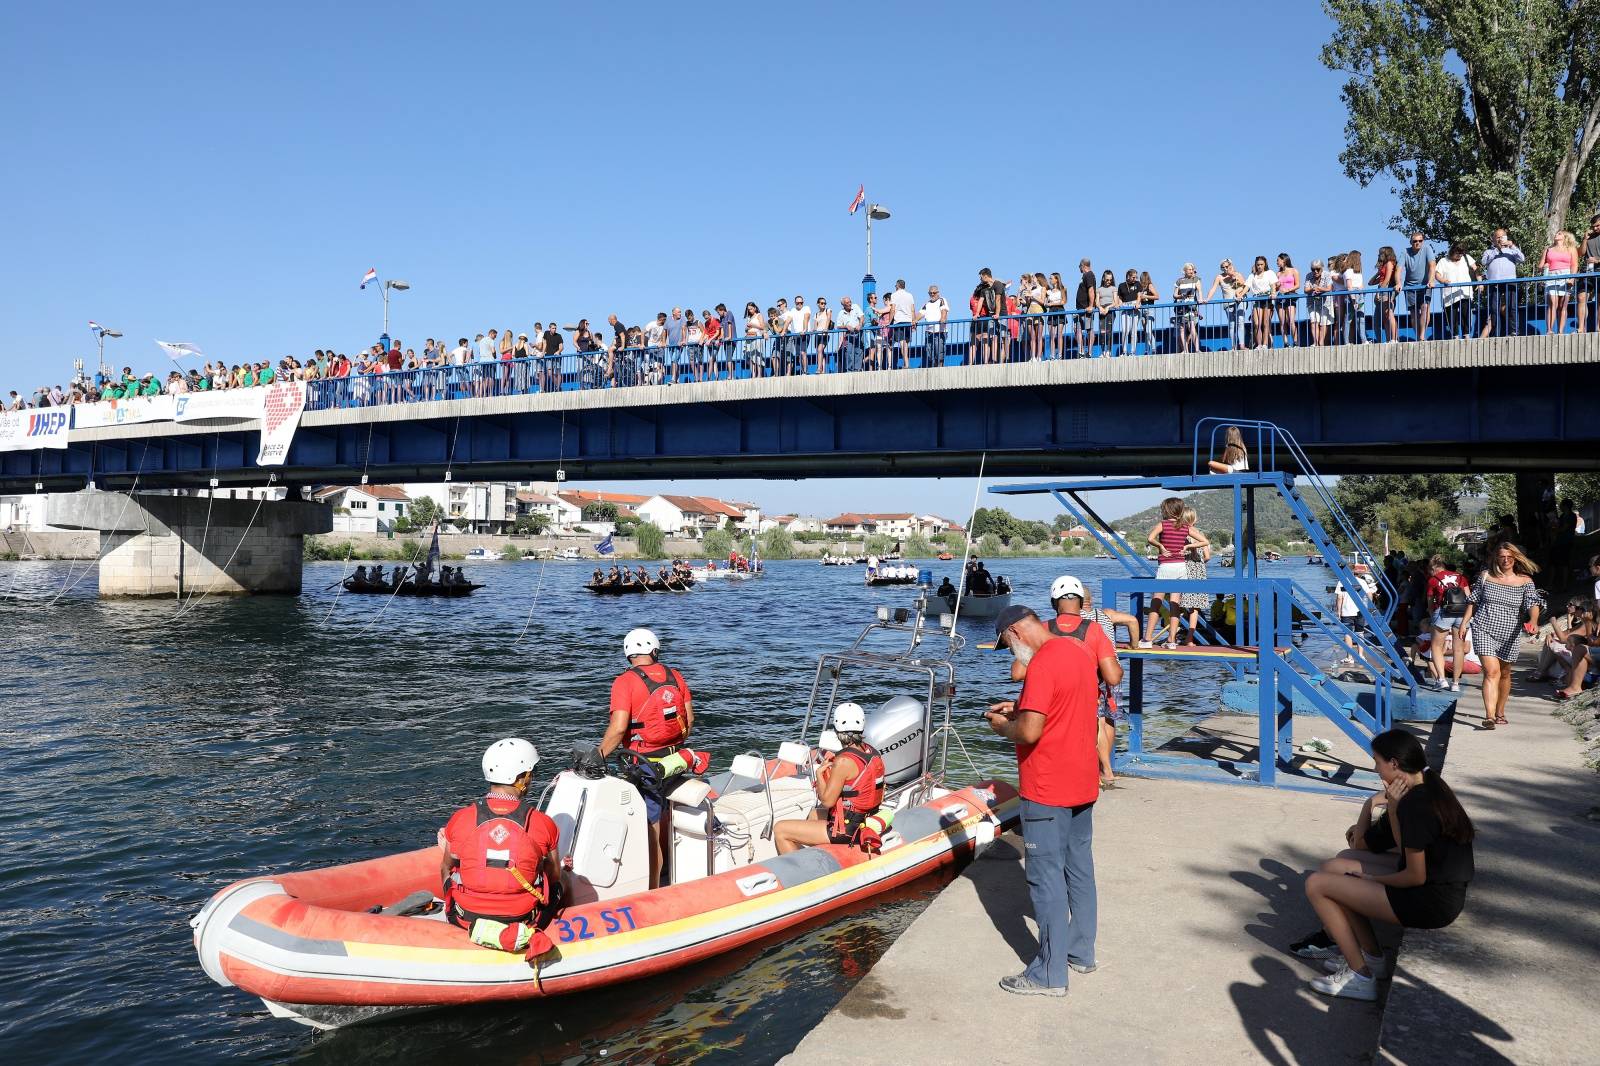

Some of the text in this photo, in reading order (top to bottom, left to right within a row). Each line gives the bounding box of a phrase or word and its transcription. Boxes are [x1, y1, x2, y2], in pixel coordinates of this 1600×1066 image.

[39, 412, 67, 435] HEP
[879, 727, 925, 755] HONDA
[554, 906, 636, 943] 32 ST
